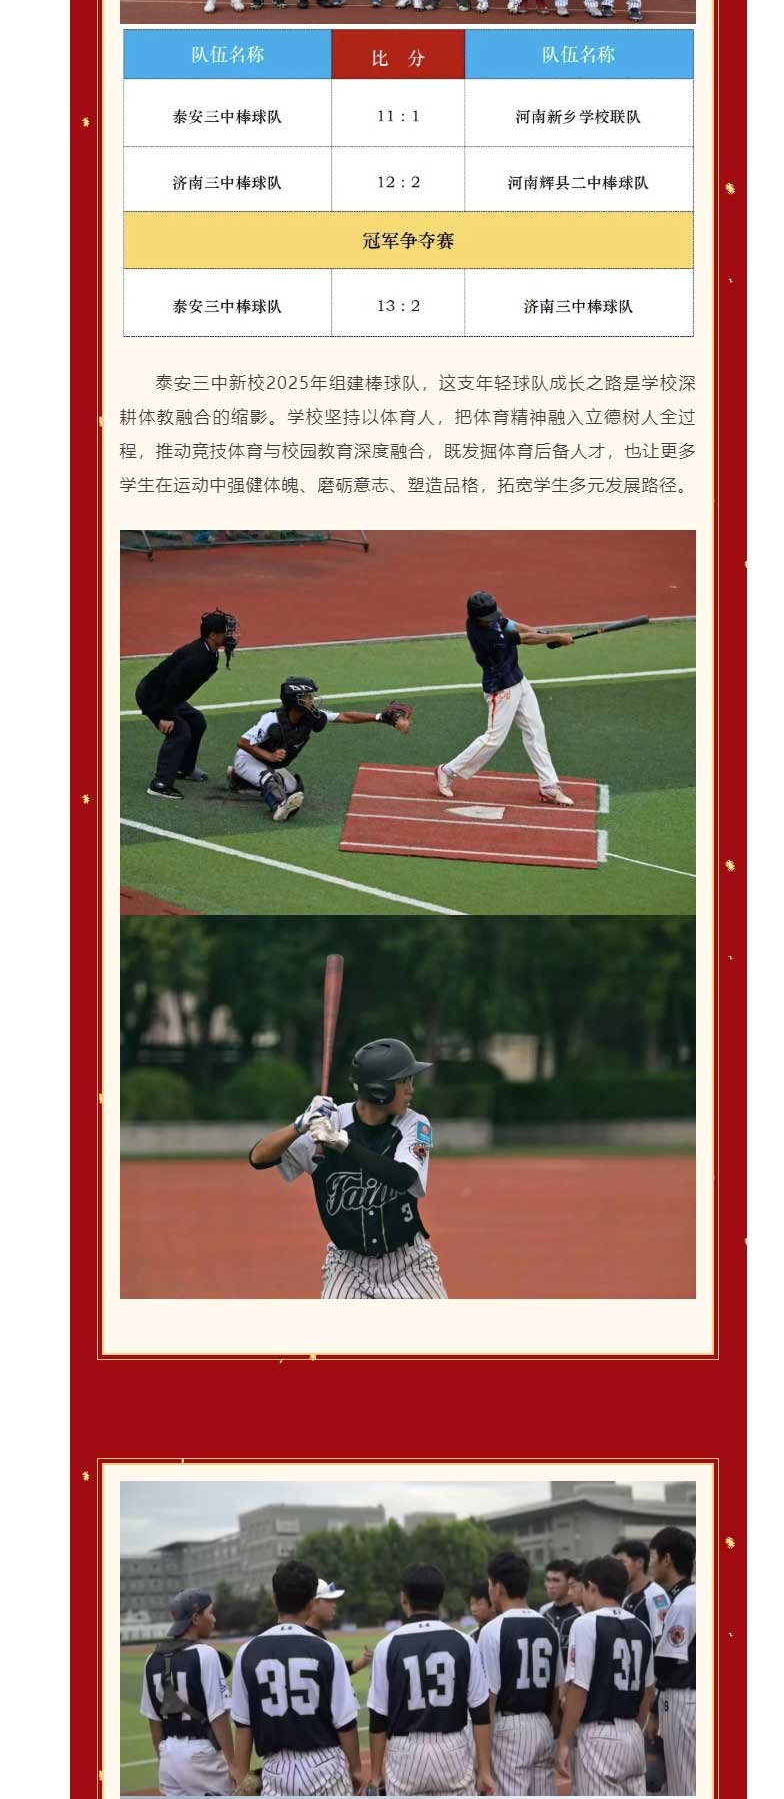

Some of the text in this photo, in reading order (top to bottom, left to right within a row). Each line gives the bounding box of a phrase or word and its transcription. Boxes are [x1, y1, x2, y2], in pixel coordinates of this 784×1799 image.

[193, 46, 263, 62] 队伍名称
[373, 50, 424, 66] 比 分
[544, 46, 614, 63] 队伍名称
[173, 109, 282, 124] 泰安三中棒球队
[516, 109, 640, 124] 河南新乡学校联队
[173, 175, 281, 190] 济南三中棒球队
[508, 175, 648, 190] 河南辉县二中棒球队
[363, 232, 454, 249] 冠军争夺赛
[173, 299, 281, 314] 泰安三中棒球队
[524, 299, 632, 314] 济南三中棒球队
[156, 374, 695, 392] 泰安三中新校2025年组建棒球队，这支年轻球队成长之路是学校深
[120, 408, 695, 426] 耕体教融合的缩影。学校坚持以体育人，把体育精神融入立德树人全过
[120, 442, 695, 459] 程，推动竞技体育与校园教育深度融合，既发掘体育后备人才，也让更多
[120, 477, 683, 493] 学生在运动中强健体魄、磨砺意志、塑造品格，拓宽学生多元发展路径。
[516, 1637, 552, 1689] 16
[613, 1637, 643, 1691] 31
[255, 1658, 320, 1717] 35
[403, 1651, 455, 1711] 13
